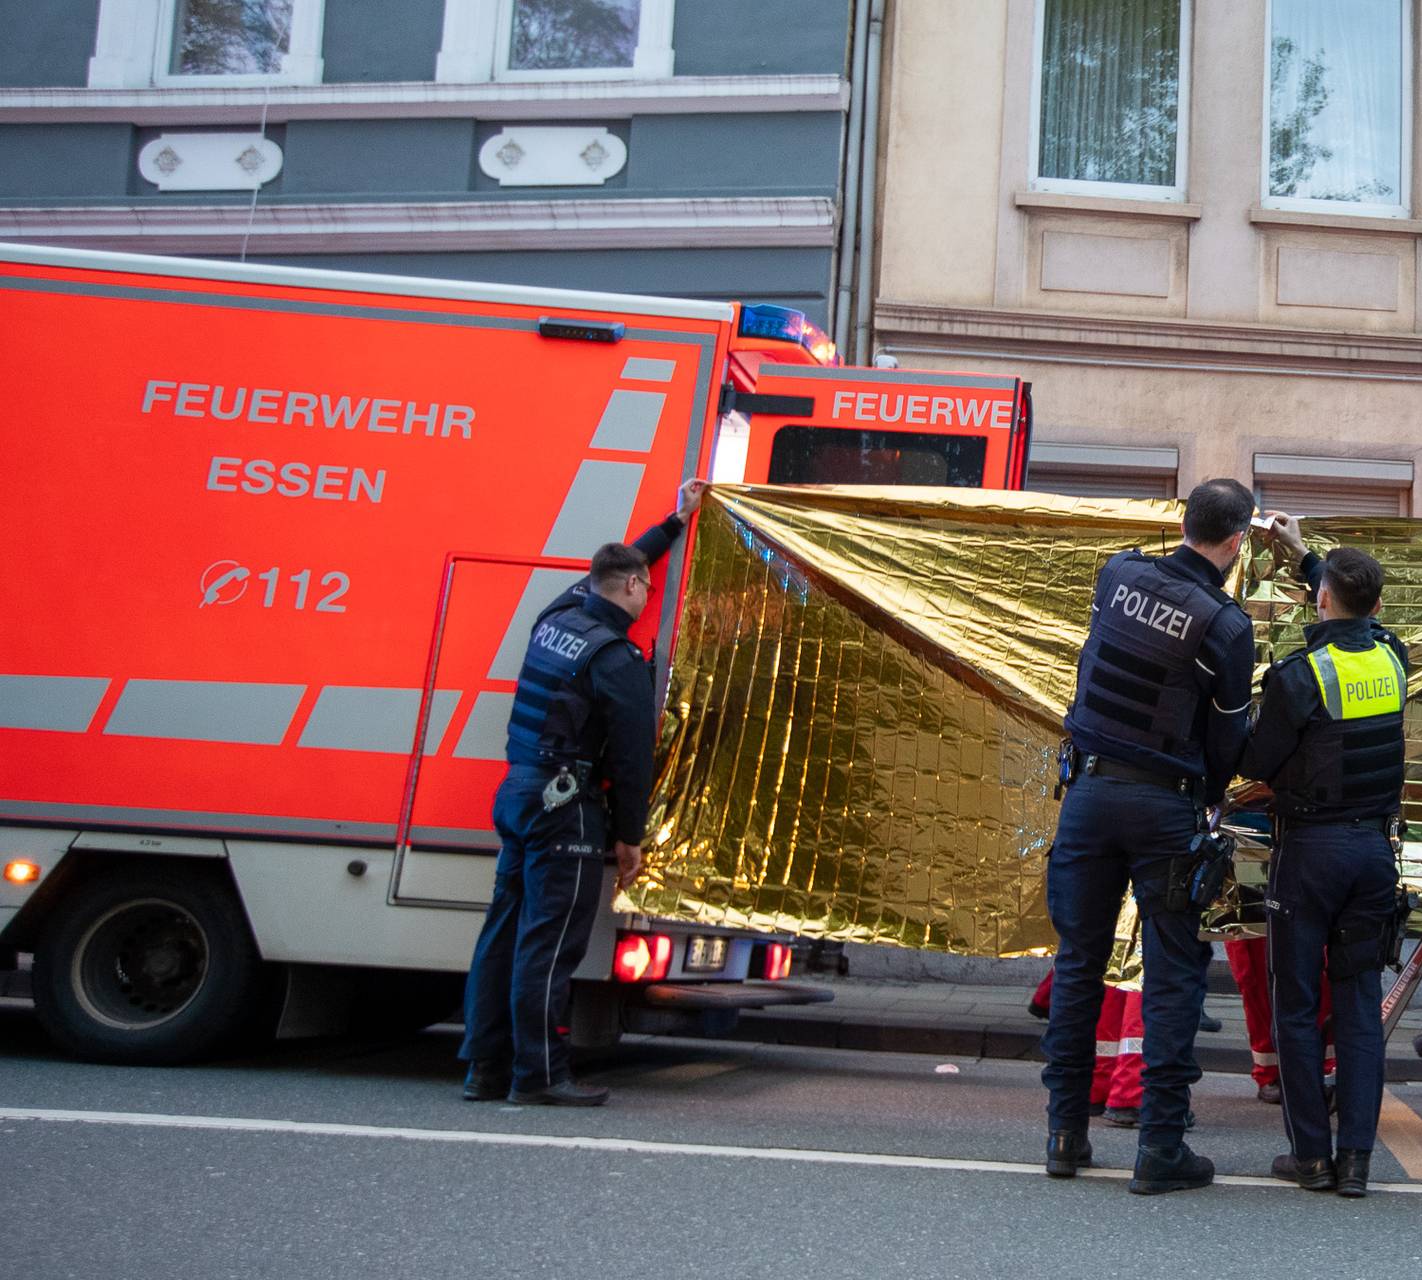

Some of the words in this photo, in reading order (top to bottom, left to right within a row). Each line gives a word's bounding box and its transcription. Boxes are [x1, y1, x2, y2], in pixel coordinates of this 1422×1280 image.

[141, 380, 476, 439] FEUERWEHR
[832, 391, 1013, 429] FEUERWE
[206, 456, 386, 503] ESSEN
[258, 566, 350, 612] 112
[1109, 583, 1193, 641] POLIZEI
[533, 623, 588, 661] POLIZEI
[1346, 676, 1396, 702] POLIZEI
